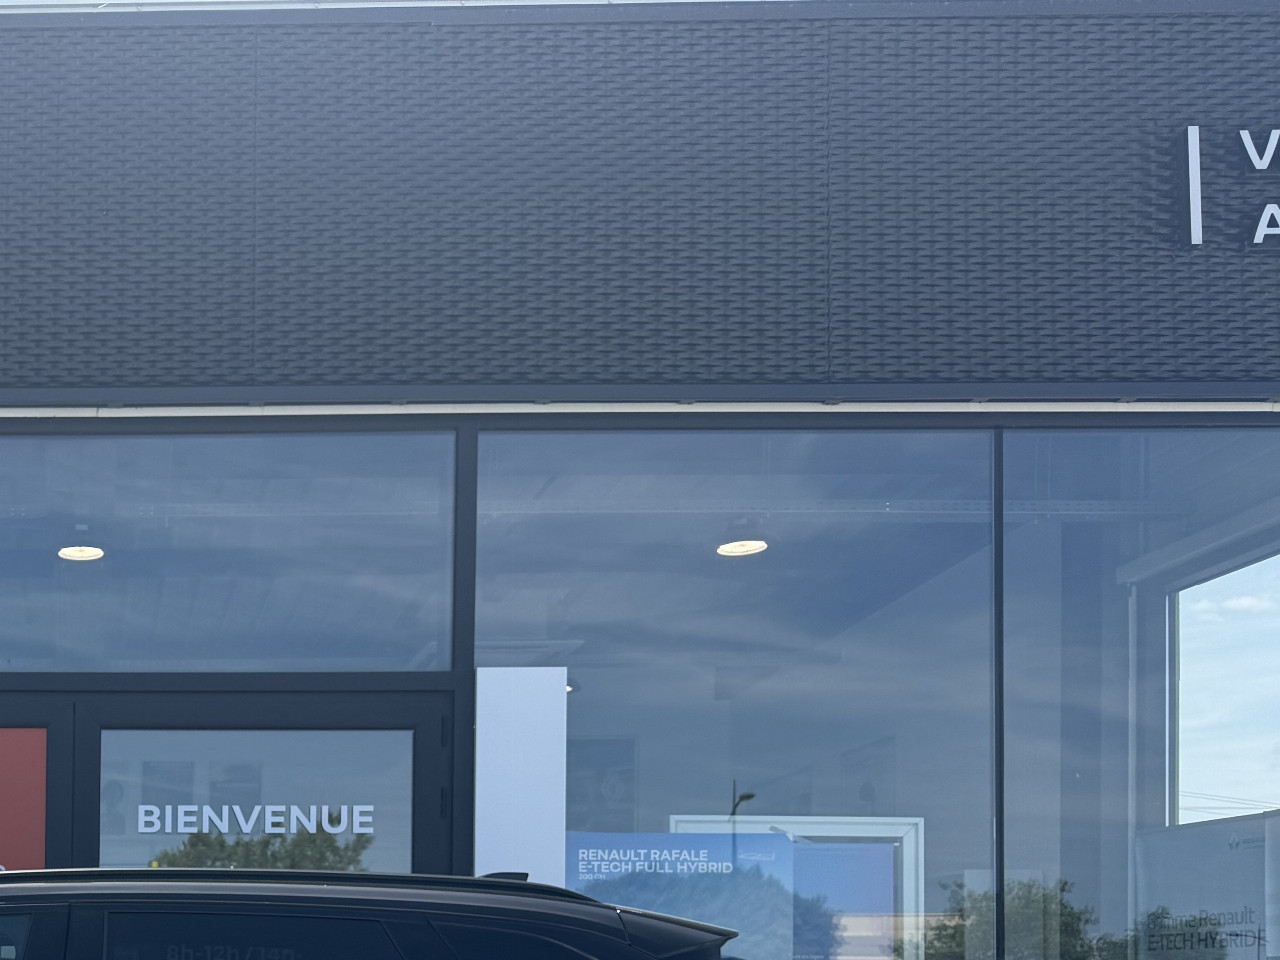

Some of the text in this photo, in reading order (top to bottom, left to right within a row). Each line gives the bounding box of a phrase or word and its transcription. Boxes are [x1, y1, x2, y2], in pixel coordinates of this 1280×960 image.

[137, 804, 375, 834] BIENVENUE
[578, 849, 708, 861] RENAULT RAFALE
[578, 861, 733, 874] E-TECH FULL HYBRID
[1199, 906, 1256, 927] Renault
